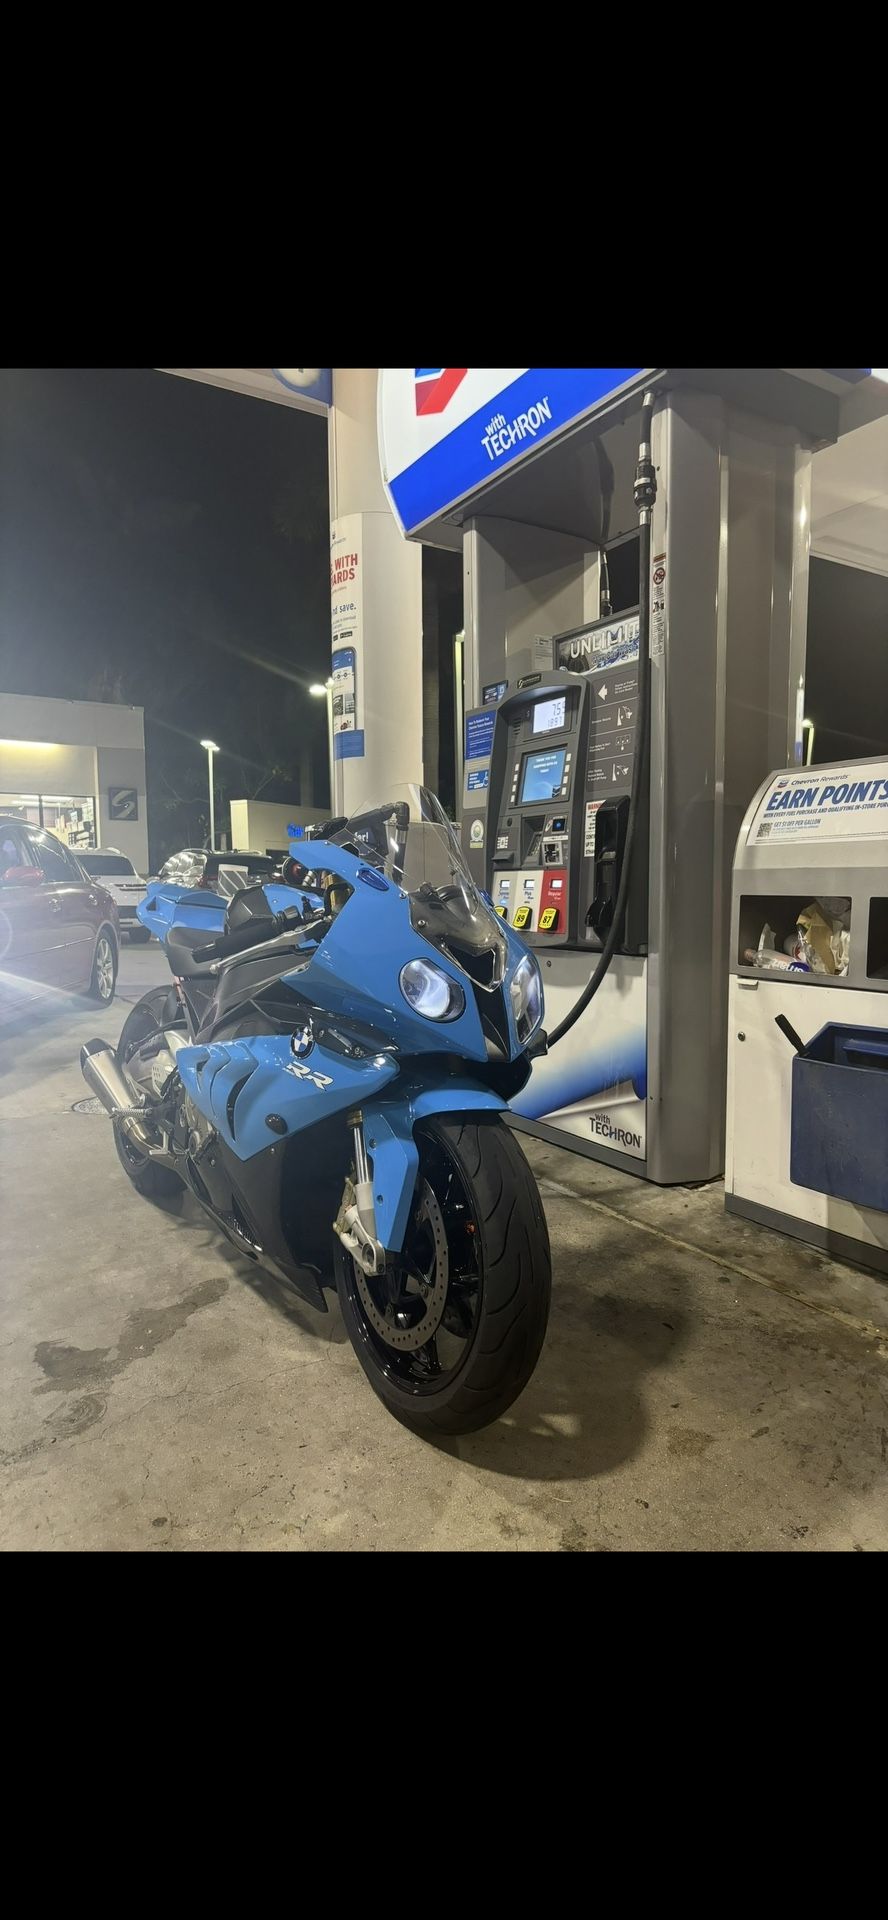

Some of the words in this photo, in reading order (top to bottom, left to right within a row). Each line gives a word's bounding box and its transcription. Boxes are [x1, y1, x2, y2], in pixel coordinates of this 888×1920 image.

[480, 397, 552, 461] TECHRON
[485, 413, 506, 436] with
[334, 553, 358, 571] WITH
[791, 778, 820, 786] Chevron
[819, 774, 848, 783] Rewards
[766, 787, 820, 811] EARN
[795, 808, 819, 816] PURCHASE
[828, 804, 854, 812] QUALIFYING
[854, 802, 877, 810] IN-STORE
[542, 915, 552, 924] 87
[282, 1061, 334, 1090] RR
[594, 1113, 611, 1125] with
[589, 1116, 641, 1149] TECHRON
